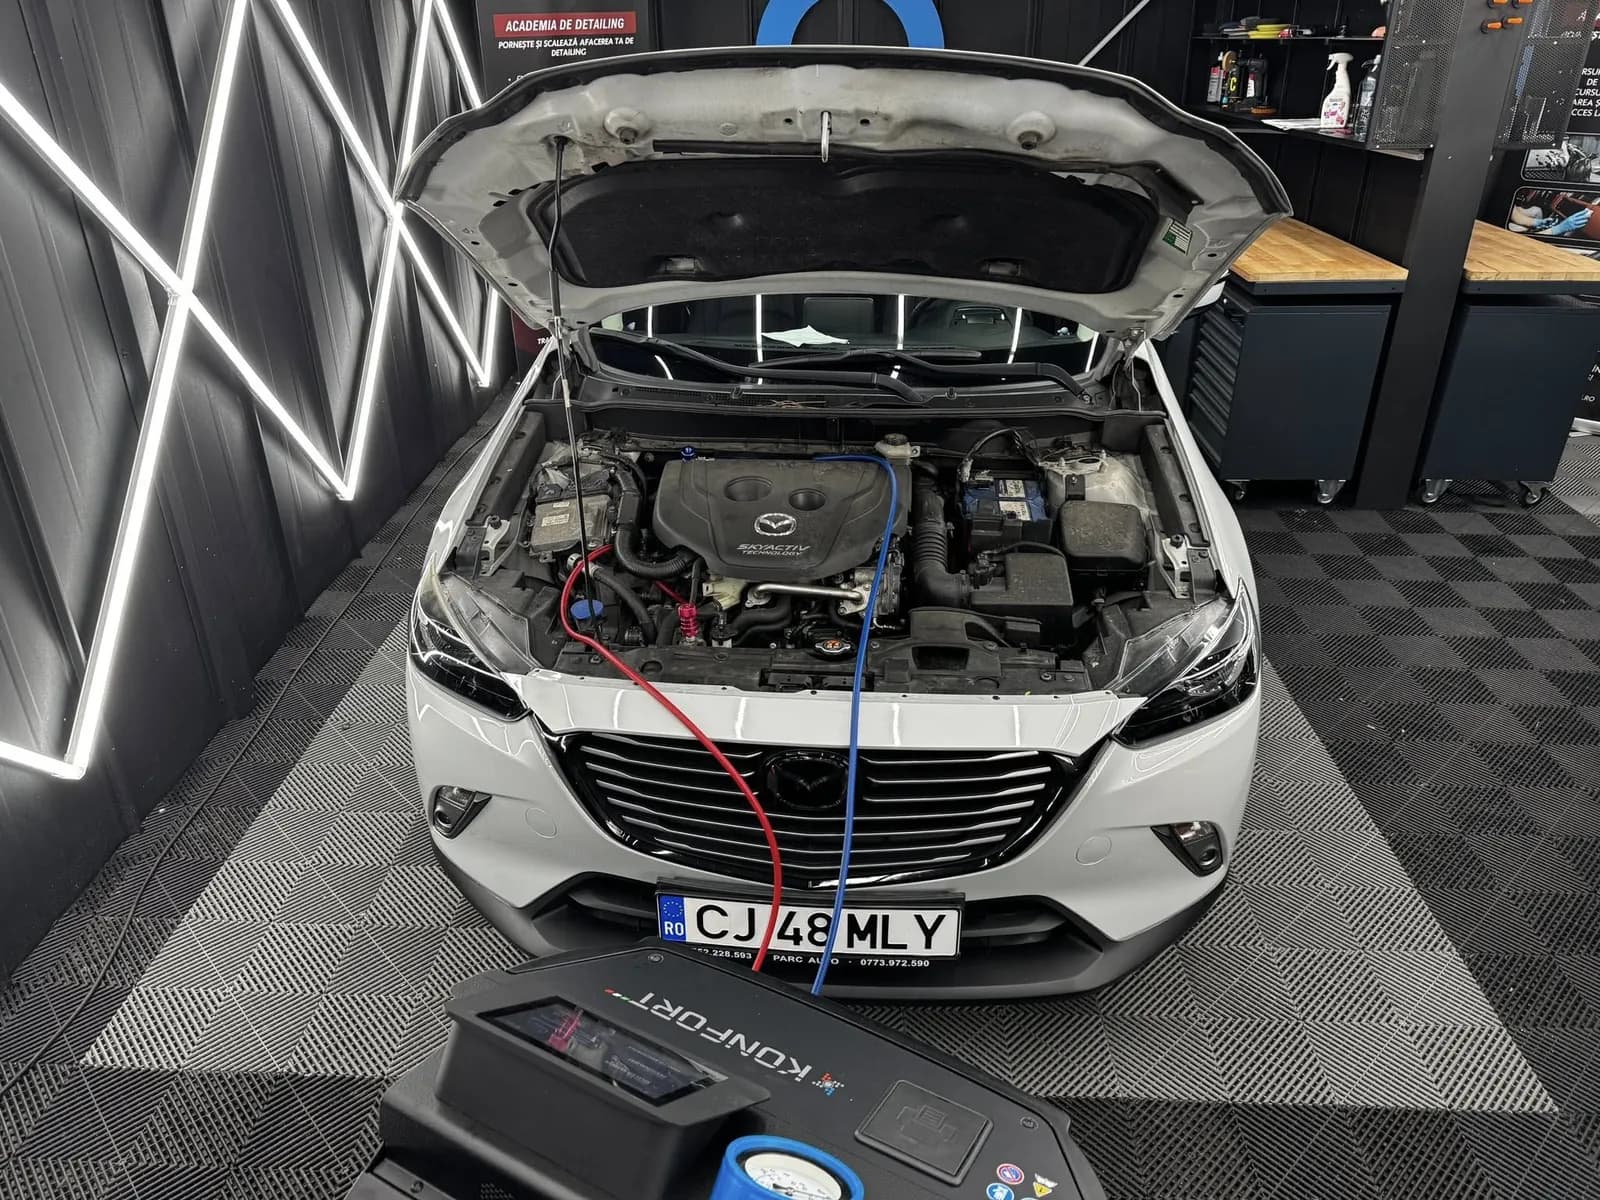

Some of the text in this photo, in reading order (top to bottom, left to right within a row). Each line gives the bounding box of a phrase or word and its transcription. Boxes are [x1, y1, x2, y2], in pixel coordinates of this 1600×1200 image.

[505, 17, 625, 32] ACADEMIA DE DETAILING
[579, 37, 614, 47] AFACEREA
[614, 37, 624, 45] TA
[624, 36, 635, 45] DE
[551, 48, 587, 58] DETAILING
[1586, 78, 1598, 86] DE
[737, 543, 811, 551] SKYACTIV
[664, 921, 684, 936] RO
[696, 904, 947, 950] CJ 48 MLY
[773, 955, 804, 963] PARC
[860, 958, 930, 968] 0773.972.590
